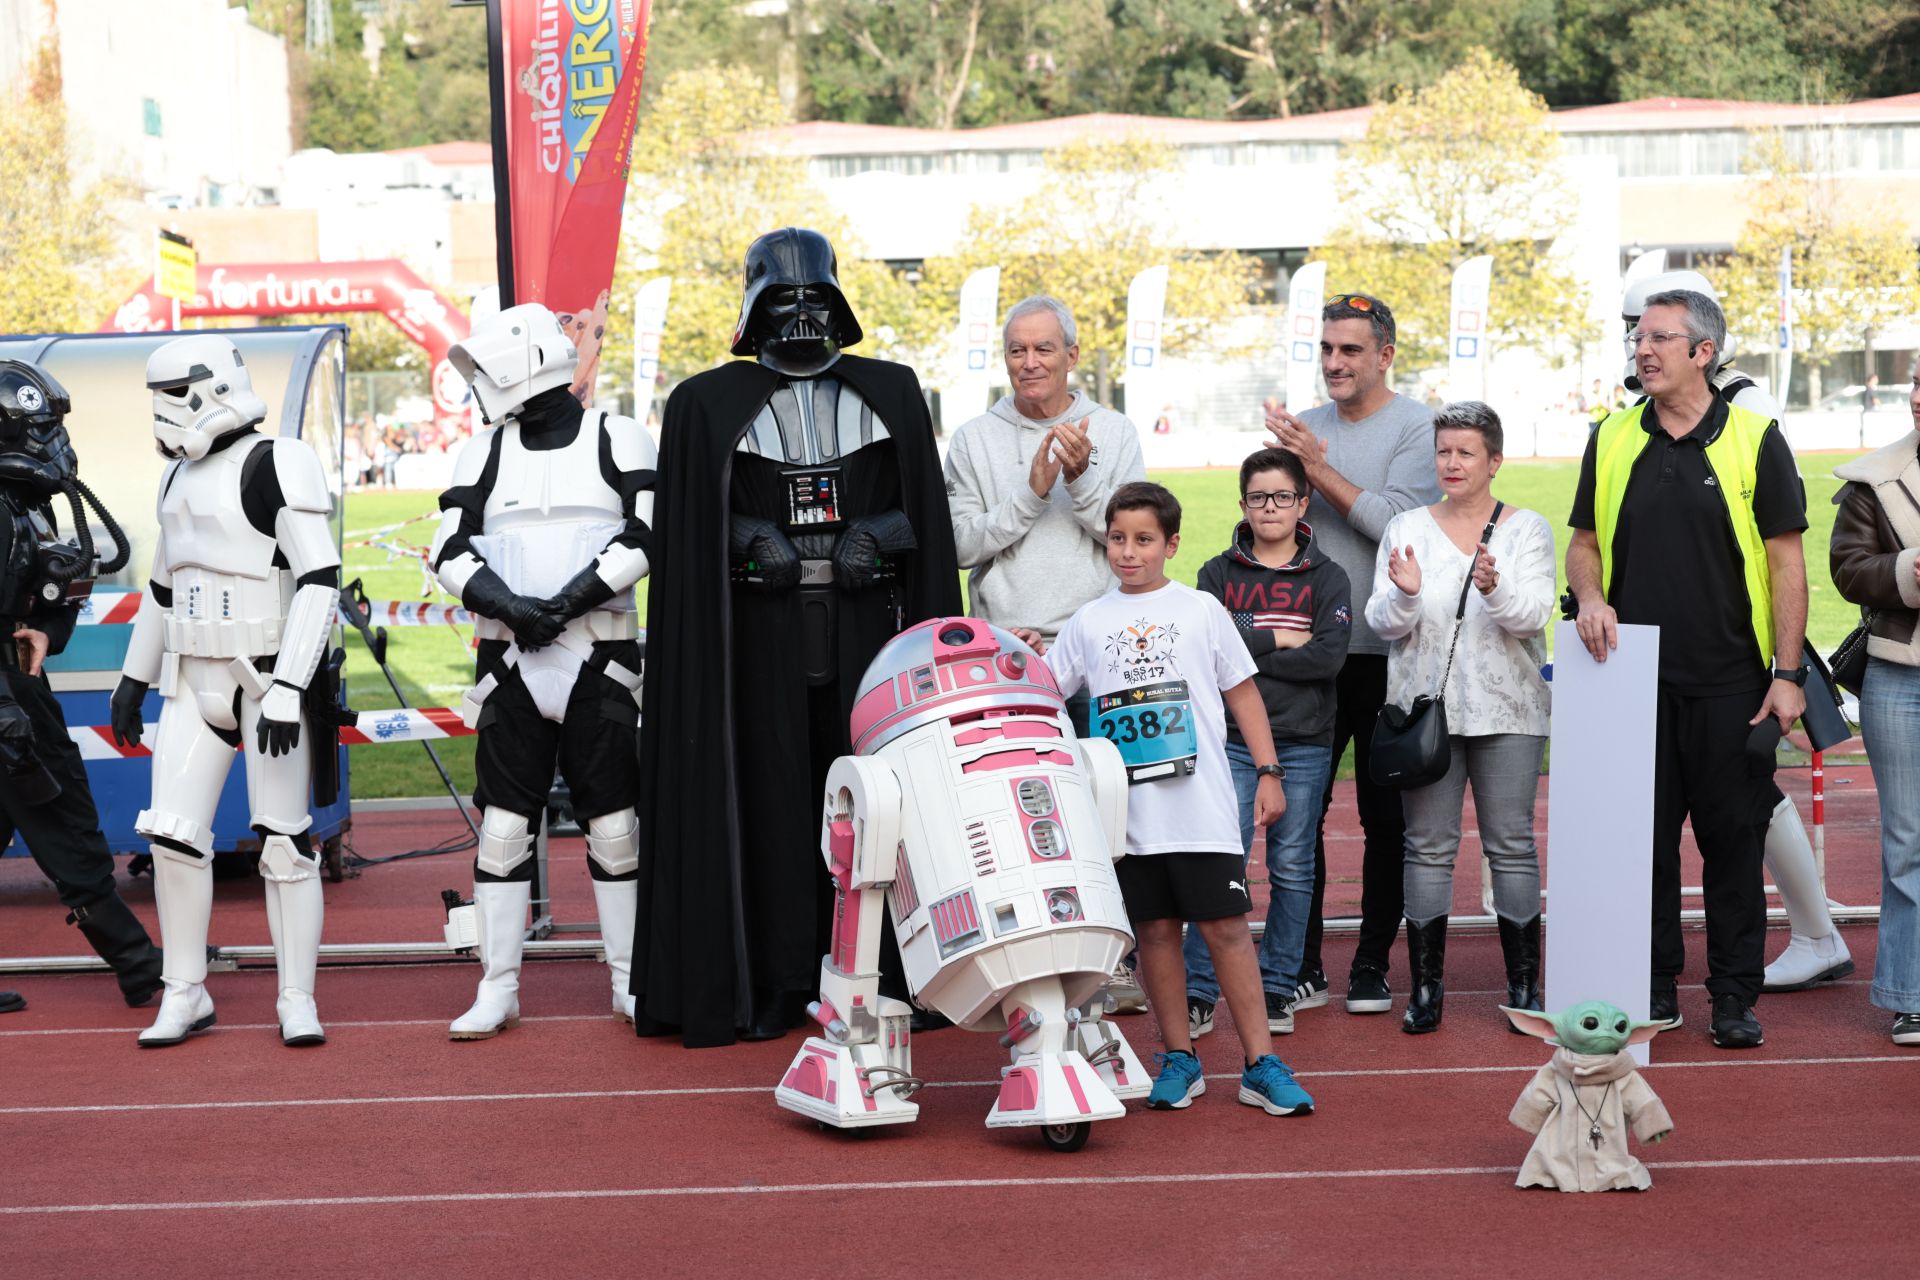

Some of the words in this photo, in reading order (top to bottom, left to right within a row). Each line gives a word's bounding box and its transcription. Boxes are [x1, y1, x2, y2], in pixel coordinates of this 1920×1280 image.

[208, 268, 350, 309] fortuna
[1225, 581, 1313, 611] NASA
[1148, 666, 1165, 678] 17
[1100, 706, 1186, 746] 2382
